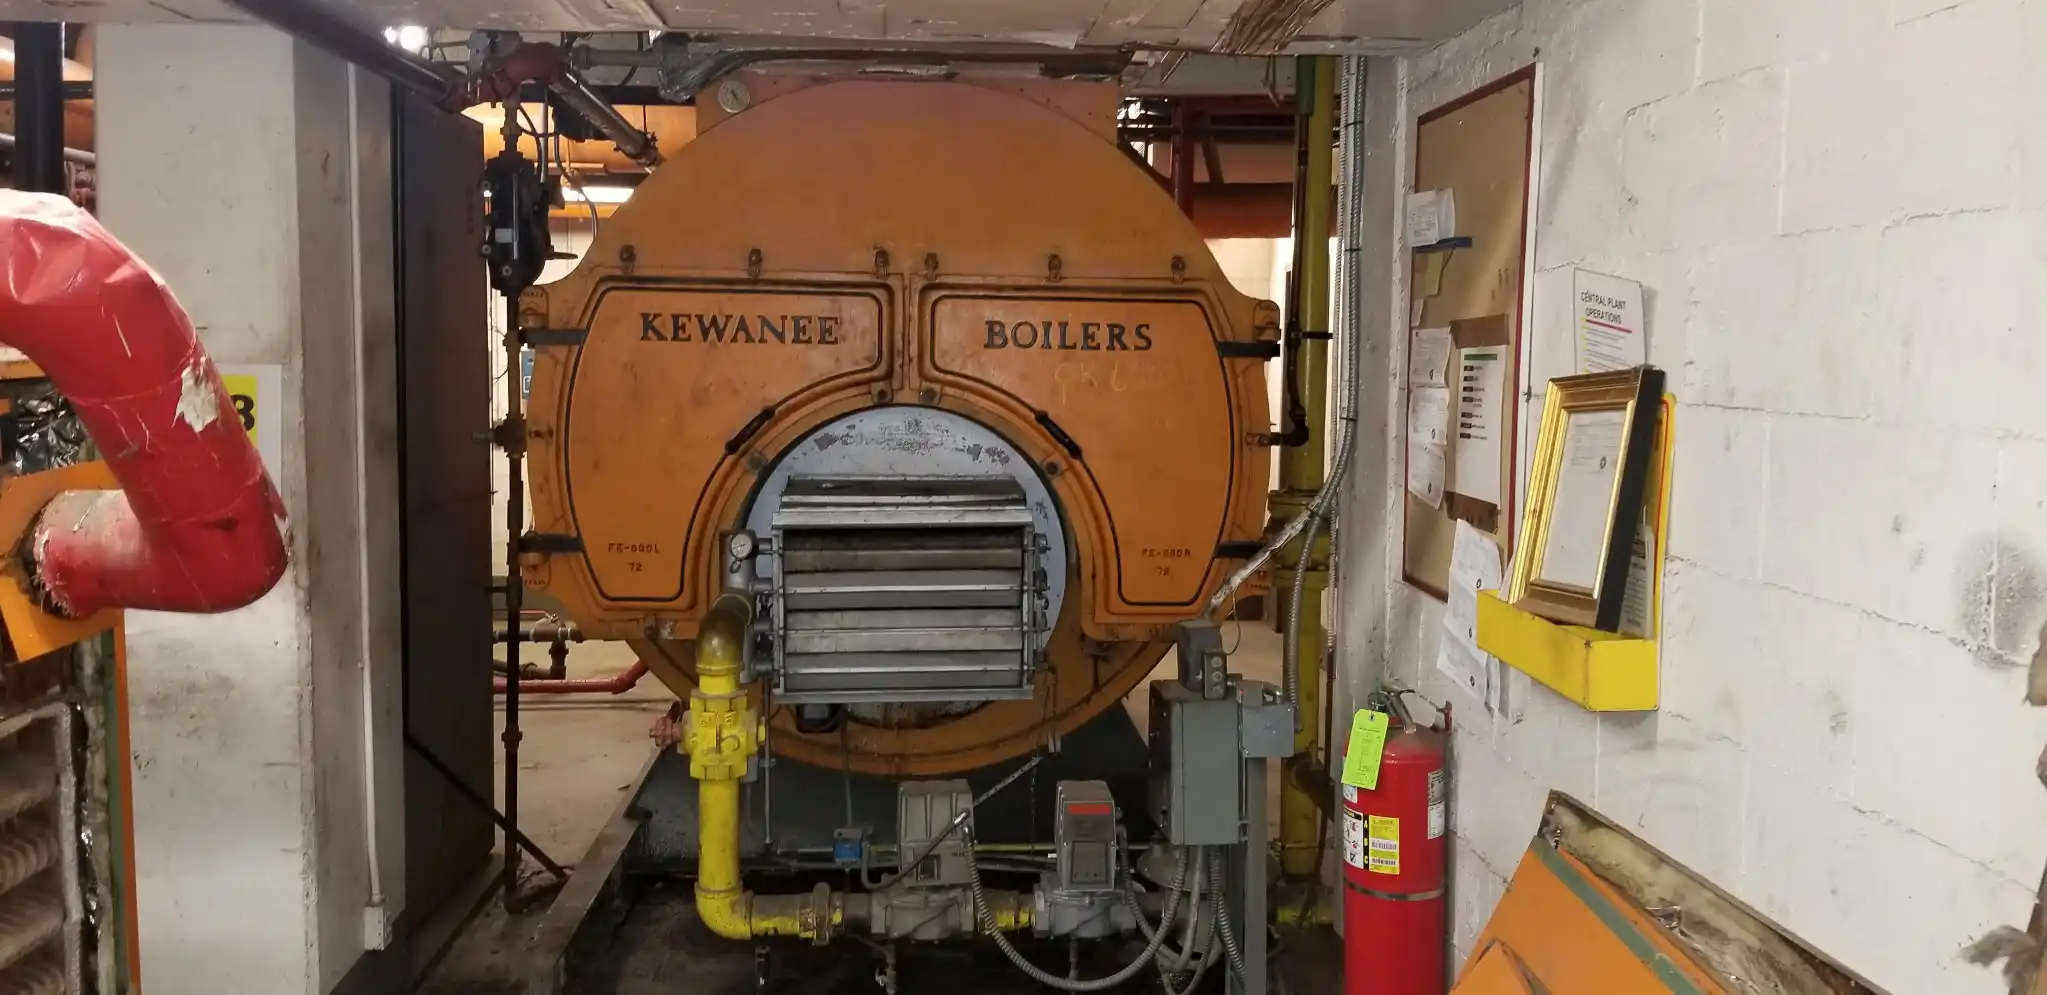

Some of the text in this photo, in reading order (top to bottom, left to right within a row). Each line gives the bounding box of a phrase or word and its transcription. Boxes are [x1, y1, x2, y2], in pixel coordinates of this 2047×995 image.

[1581, 290, 1626, 310] CENTRAL PLANT
[1585, 307, 1622, 324] OPERATIONS
[639, 312, 840, 346] KEWANEE
[983, 319, 1153, 352] BOILERS
[627, 562, 643, 572] 72
[1363, 820, 1368, 829] A
